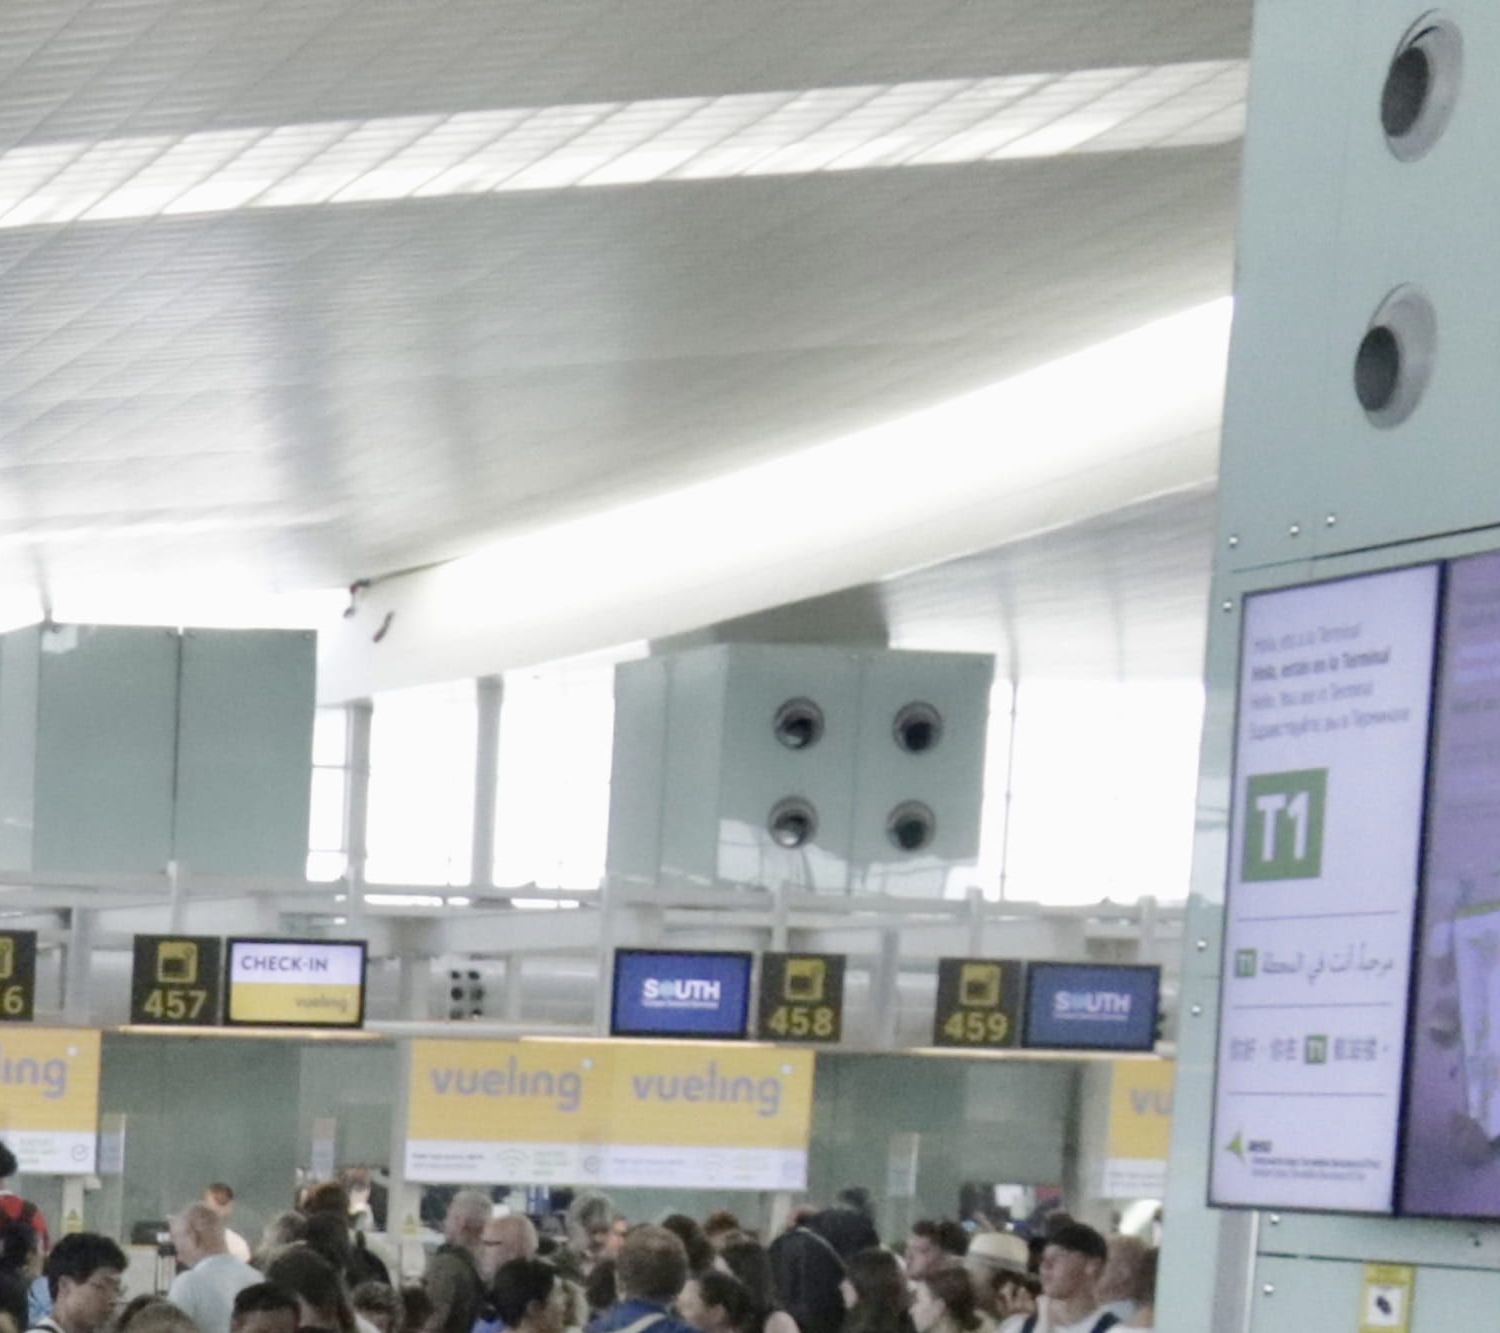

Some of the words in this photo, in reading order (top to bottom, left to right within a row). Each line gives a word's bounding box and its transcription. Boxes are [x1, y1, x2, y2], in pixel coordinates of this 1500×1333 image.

[1256, 791, 1310, 861] T1
[241, 956, 328, 973] CHECK-IN
[143, 989, 208, 1019] 457
[642, 978, 721, 1000] SOUTH
[1054, 990, 1132, 1013] SOUTH
[769, 1007, 834, 1036] 458
[944, 1012, 1009, 1042] 459
[430, 1055, 582, 1113] vueling
[632, 1060, 783, 1117] vueling
